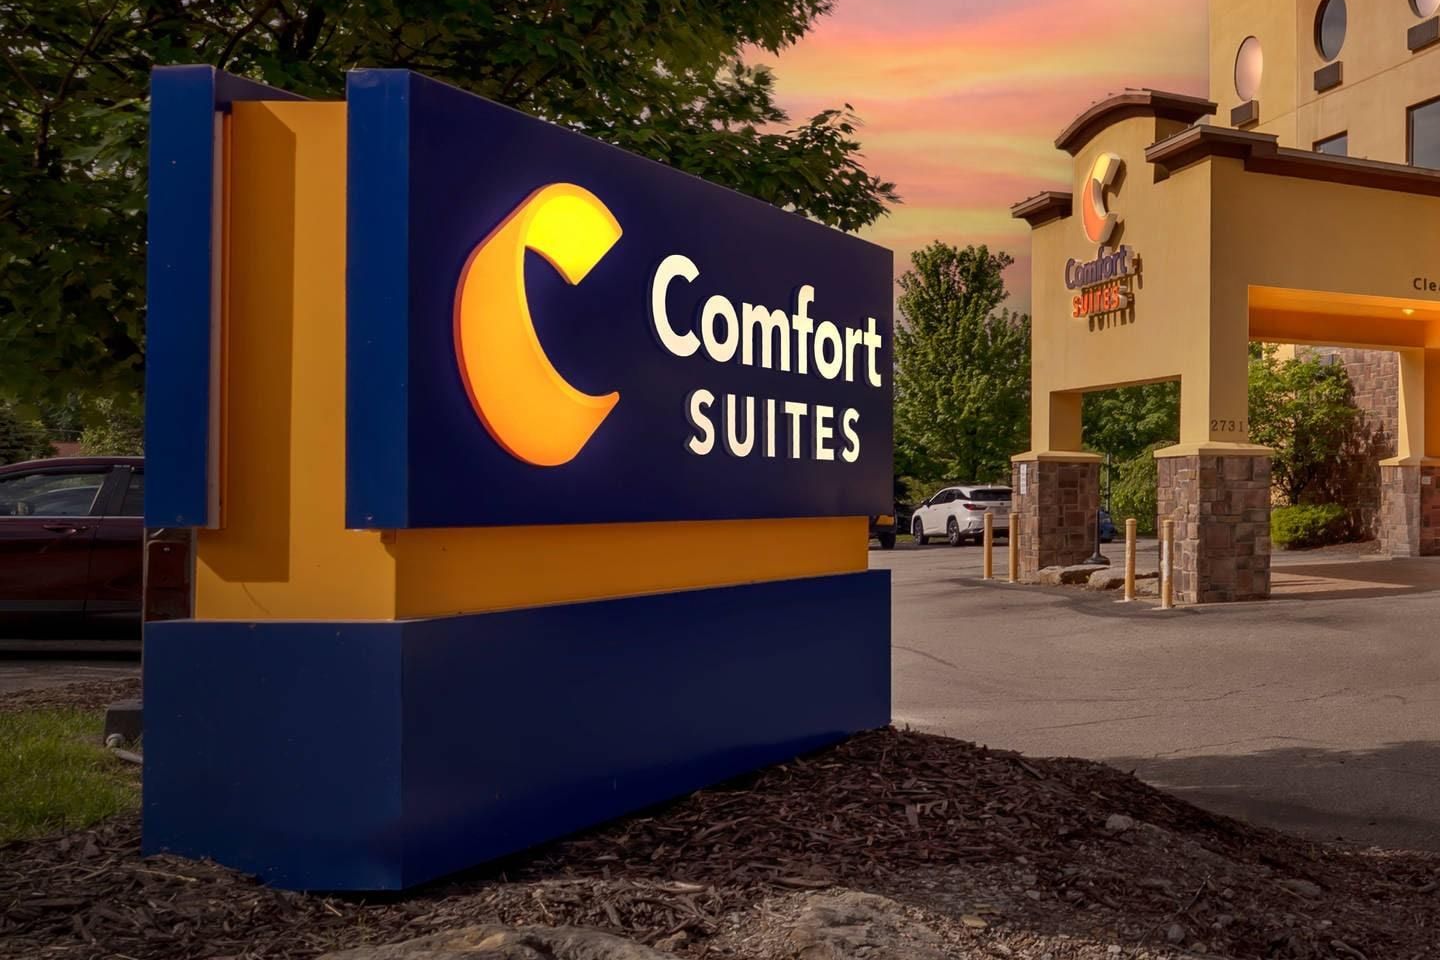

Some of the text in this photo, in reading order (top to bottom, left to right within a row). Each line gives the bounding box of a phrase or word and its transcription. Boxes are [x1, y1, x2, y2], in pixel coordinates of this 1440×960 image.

[1065, 244, 1129, 290] Comfort
[651, 254, 882, 388] Comfort
[1072, 285, 1121, 319] SUITES
[688, 389, 860, 463] SUITES
[1211, 419, 1244, 433] 2731
